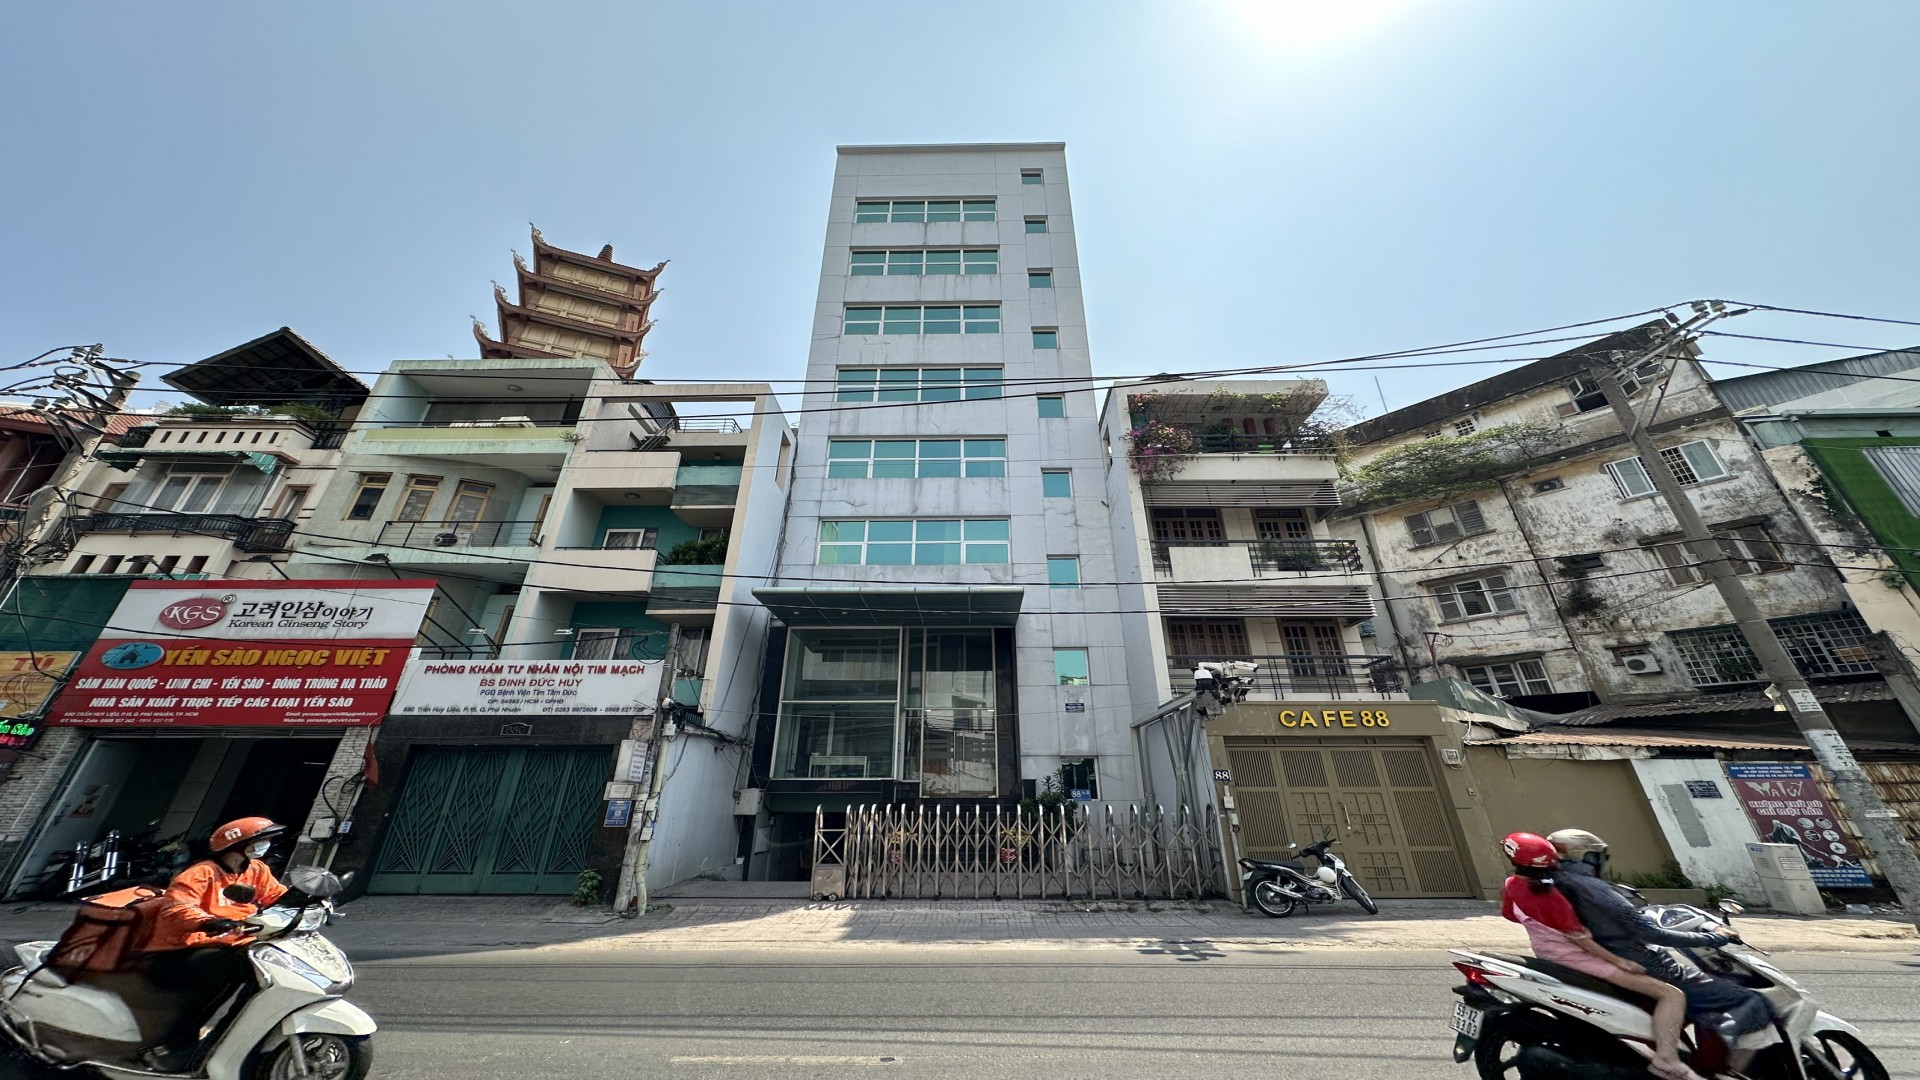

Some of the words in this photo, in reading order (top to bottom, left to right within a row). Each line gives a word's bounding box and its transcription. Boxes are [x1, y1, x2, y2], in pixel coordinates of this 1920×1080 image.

[164, 605, 222, 625] KGS
[227, 619, 273, 628] Korean
[278, 619, 330, 629] Ginseng
[333, 620, 369, 629] Story
[163, 645, 211, 666] YẾN
[211, 647, 262, 666] SÀO
[261, 650, 331, 670] NGỌC
[334, 647, 390, 669] VIỆT
[424, 663, 466, 674] PHÒNG
[468, 663, 504, 674] KHÁM
[507, 665, 524, 674] TƯ
[526, 663, 560, 674] NHÂN
[563, 663, 584, 677] NỘI
[587, 665, 607, 674] TIM
[610, 665, 645, 677] MẠCH
[101, 677, 127, 690] HÀN
[127, 676, 158, 691] QUỐC
[165, 678, 190, 690] LINH
[192, 678, 213, 690] CHI
[220, 676, 242, 689] YẾN
[242, 677, 264, 690] SÀO
[272, 677, 302, 690] ĐÔNG
[304, 677, 341, 690] TRÙNG
[340, 678, 356, 691] HẠ
[359, 676, 388, 690] THẢO
[480, 679, 495, 687] BS
[498, 679, 526, 687] ĐINH
[529, 678, 555, 687] ĐỨC
[558, 679, 584, 687] HUY
[89, 696, 117, 707] NHÀ
[118, 695, 146, 707] SẢN
[145, 695, 179, 708] XUẤT
[180, 697, 214, 709] TRỰC
[216, 695, 243, 708] TIẾP
[243, 697, 270, 708] CÁC
[271, 698, 300, 709] LOẠI
[302, 695, 327, 708] YẾN
[327, 696, 353, 708] SÀO
[1360, 710, 1390, 728] 88
[1215, 771, 1230, 780] 88
[1072, 790, 1082, 798] 88
[1749, 800, 1786, 808] KHÔNG
